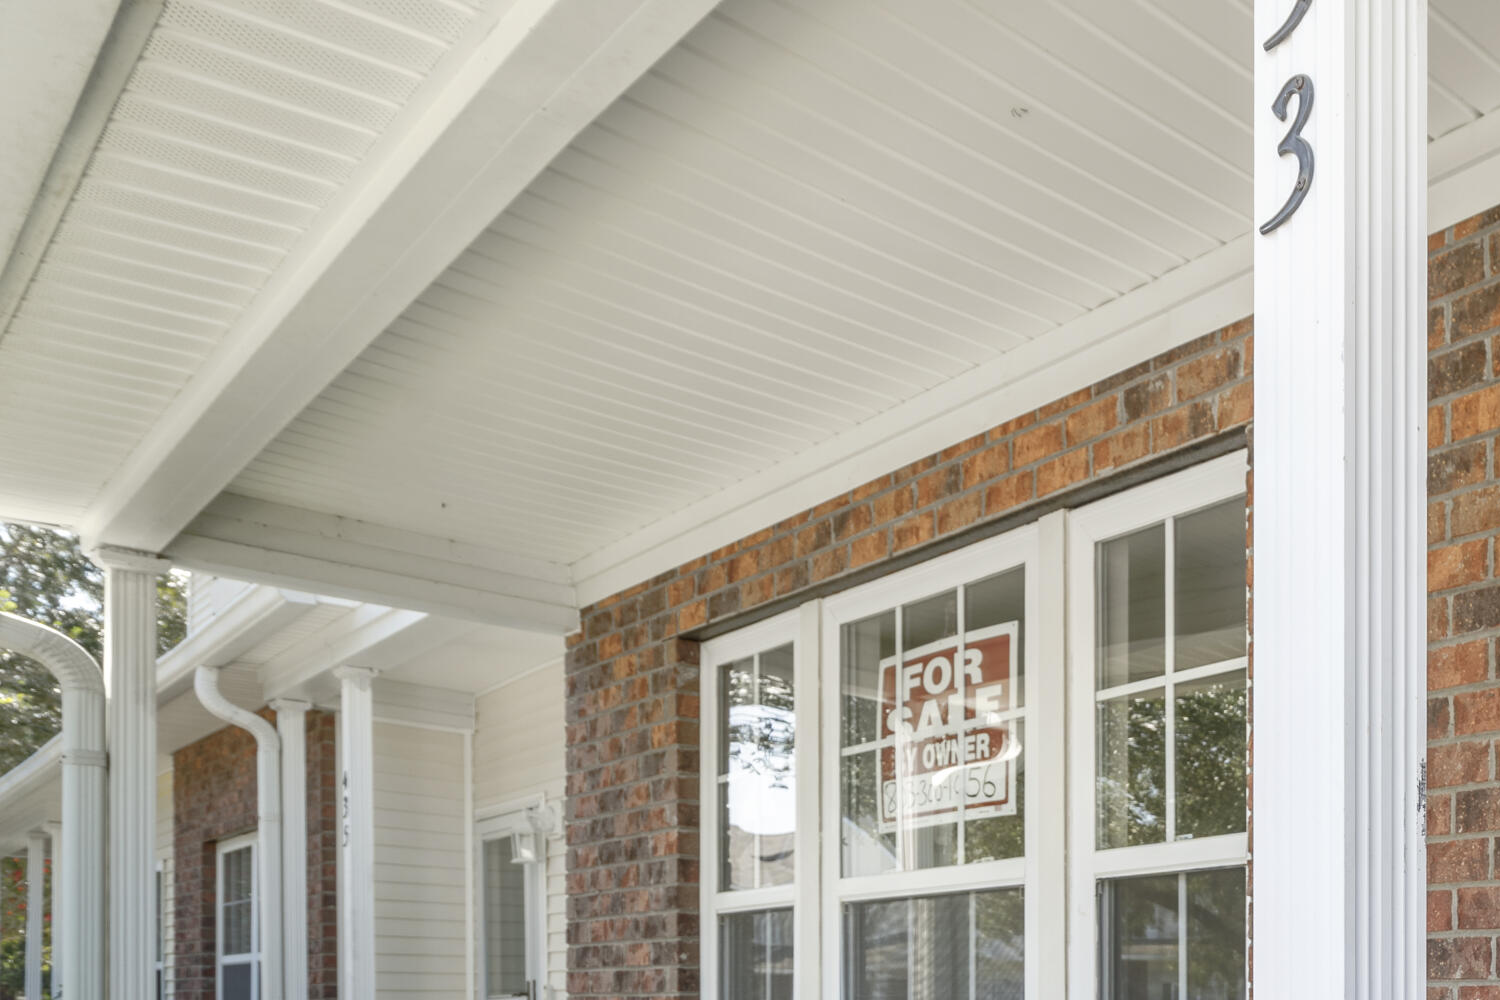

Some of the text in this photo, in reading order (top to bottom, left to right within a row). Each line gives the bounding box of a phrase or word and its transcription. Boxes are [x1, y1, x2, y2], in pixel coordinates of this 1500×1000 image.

[1259, 0, 1315, 235] 3
[903, 648, 983, 701] FOR
[922, 733, 990, 768] OWNER
